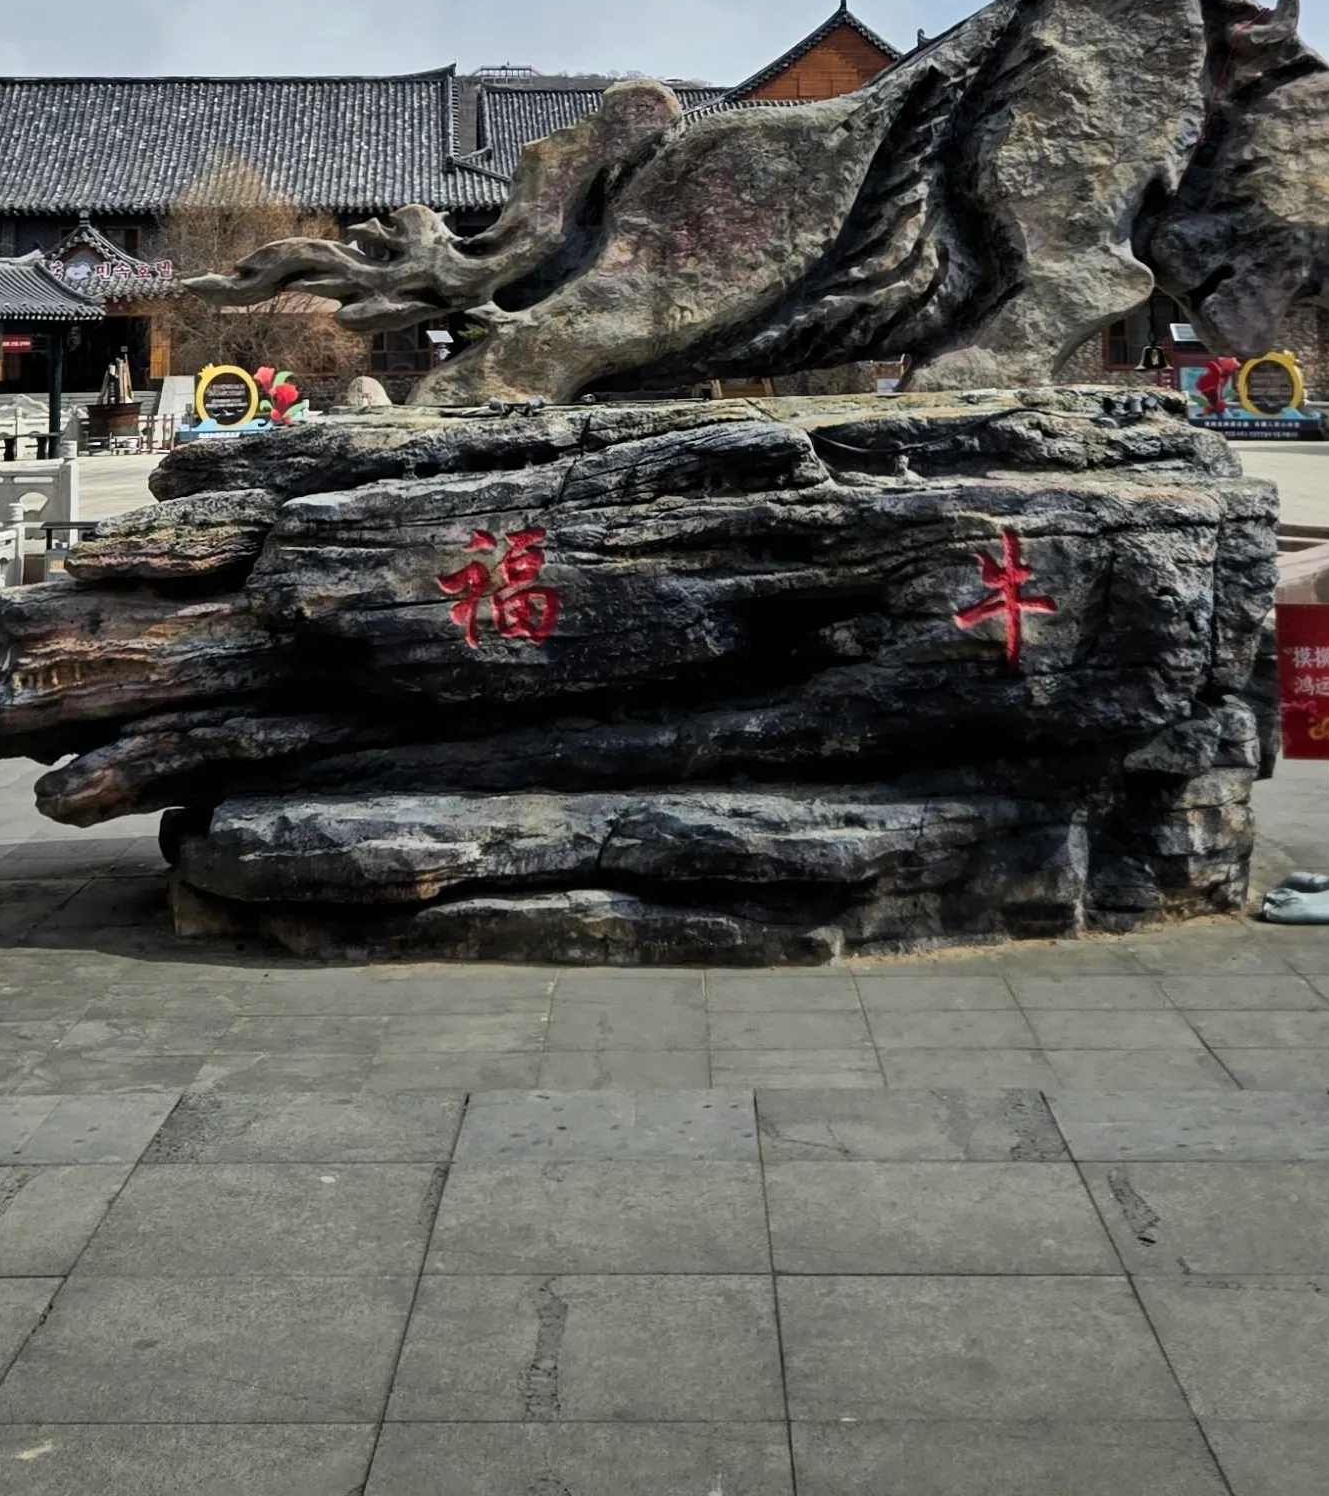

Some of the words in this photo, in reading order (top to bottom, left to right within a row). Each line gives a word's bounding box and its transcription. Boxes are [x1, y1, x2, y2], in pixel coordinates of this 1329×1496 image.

[94, 259, 173, 280] 민속호텔
[437, 527, 560, 649] 福
[955, 527, 1057, 671] 牛
